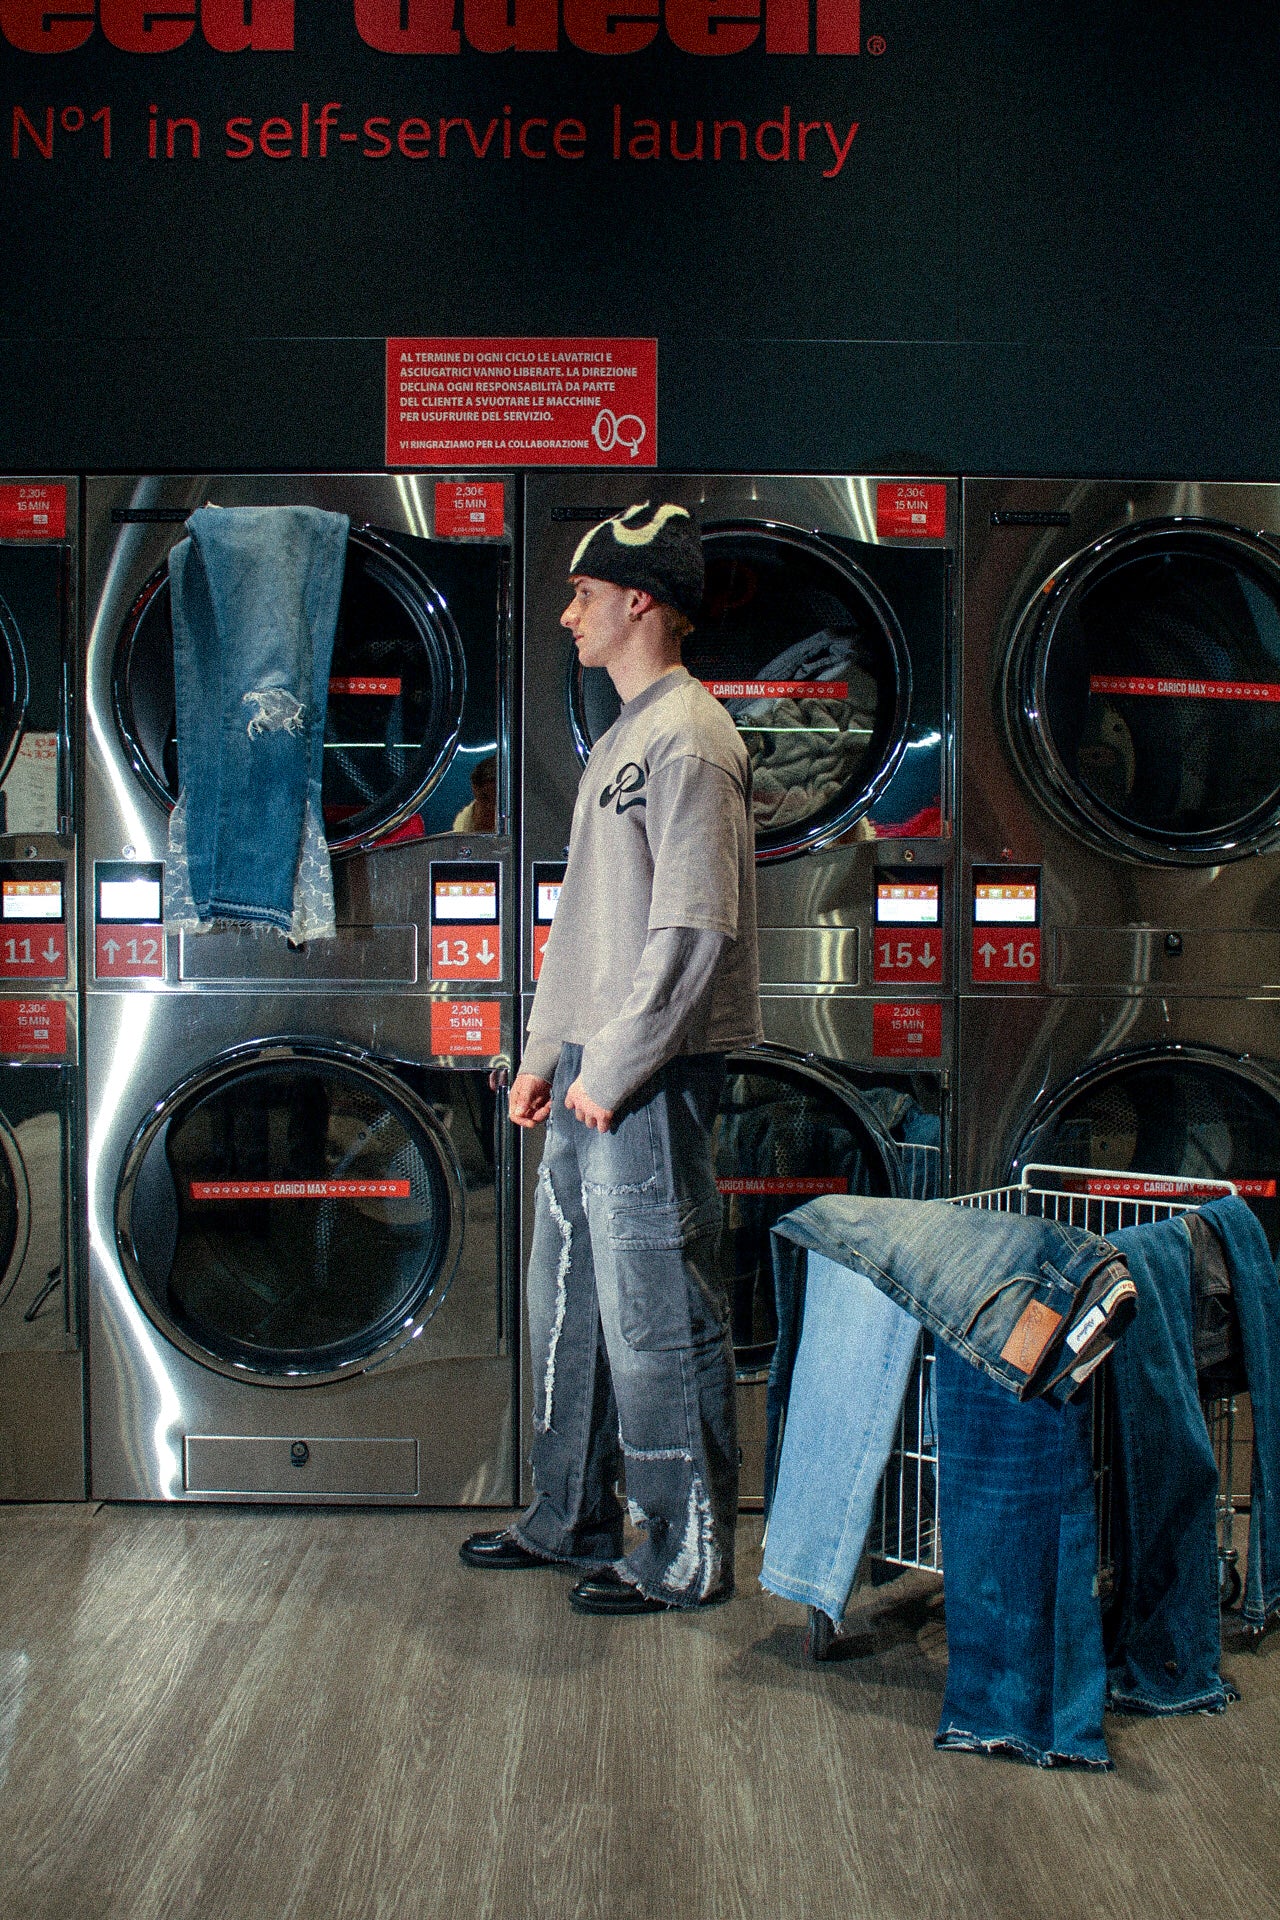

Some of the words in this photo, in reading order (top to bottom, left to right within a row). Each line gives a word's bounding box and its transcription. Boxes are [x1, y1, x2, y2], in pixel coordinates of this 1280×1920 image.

[148, 104, 201, 159] in
[225, 103, 587, 160] self-service
[613, 104, 860, 178] laundry
[400, 352, 414, 363] AL
[415, 352, 461, 363] TERMINE
[463, 352, 474, 363] DI
[476, 352, 503, 363] OGNI
[505, 352, 536, 363] CICLO
[537, 352, 550, 363] LE
[551, 352, 604, 363] LAVATRICI
[606, 352, 613, 363] E
[400, 367, 472, 378] ASCIUGATRICI
[473, 367, 512, 378] VANNO
[513, 367, 565, 378] LIBERATE.
[566, 367, 580, 378] LA
[582, 367, 637, 378] DIREZIONE
[400, 381, 445, 392] DECLINA
[446, 381, 474, 392] OGNI
[475, 379, 563, 392] RESPONSABILITÀ
[565, 381, 581, 392] DA
[582, 381, 616, 392] PARTE
[400, 396, 419, 407] DEL
[421, 396, 464, 407] CLIENTE
[465, 396, 473, 407] A
[475, 396, 531, 407] SVUOTARE
[532, 396, 545, 407] LE
[546, 396, 602, 407] MACCHINE
[400, 411, 420, 422] PER
[421, 411, 480, 422] USUFRUIRE
[481, 411, 501, 422] DEL
[503, 411, 555, 422] SERVIZIO.
[399, 439, 409, 449] VI
[410, 439, 475, 449] RINGRAZIAMO
[476, 439, 493, 449] PER
[494, 439, 506, 449] LA
[507, 439, 590, 449] COLLABORAZIONE
[17, 501, 27, 511] 15
[28, 501, 50, 511] MIN
[453, 499, 464, 509] 15
[465, 499, 487, 509] MIN
[894, 500, 905, 510] 15
[906, 500, 929, 510] MIN
[713, 684, 744, 695] CARICO
[745, 684, 766, 695] MAX
[1157, 681, 1187, 694] CARICO
[1187, 683, 1207, 695] MAX
[4, 938, 35, 964] 11
[125, 938, 159, 965] 12
[436, 940, 470, 966] 13
[879, 942, 913, 968] 15
[1002, 942, 1036, 968] 16
[17, 1016, 28, 1026] 15
[29, 1016, 50, 1026] MIN
[449, 1018, 460, 1028] 15
[461, 1018, 483, 1028] MIN
[891, 1020, 902, 1030] 15
[902, 1020, 924, 1030] MIN
[274, 1183, 305, 1195] CARICO
[307, 1183, 327, 1195] MAX
[745, 1179, 765, 1190] MAX
[1143, 1181, 1174, 1193] CARICO
